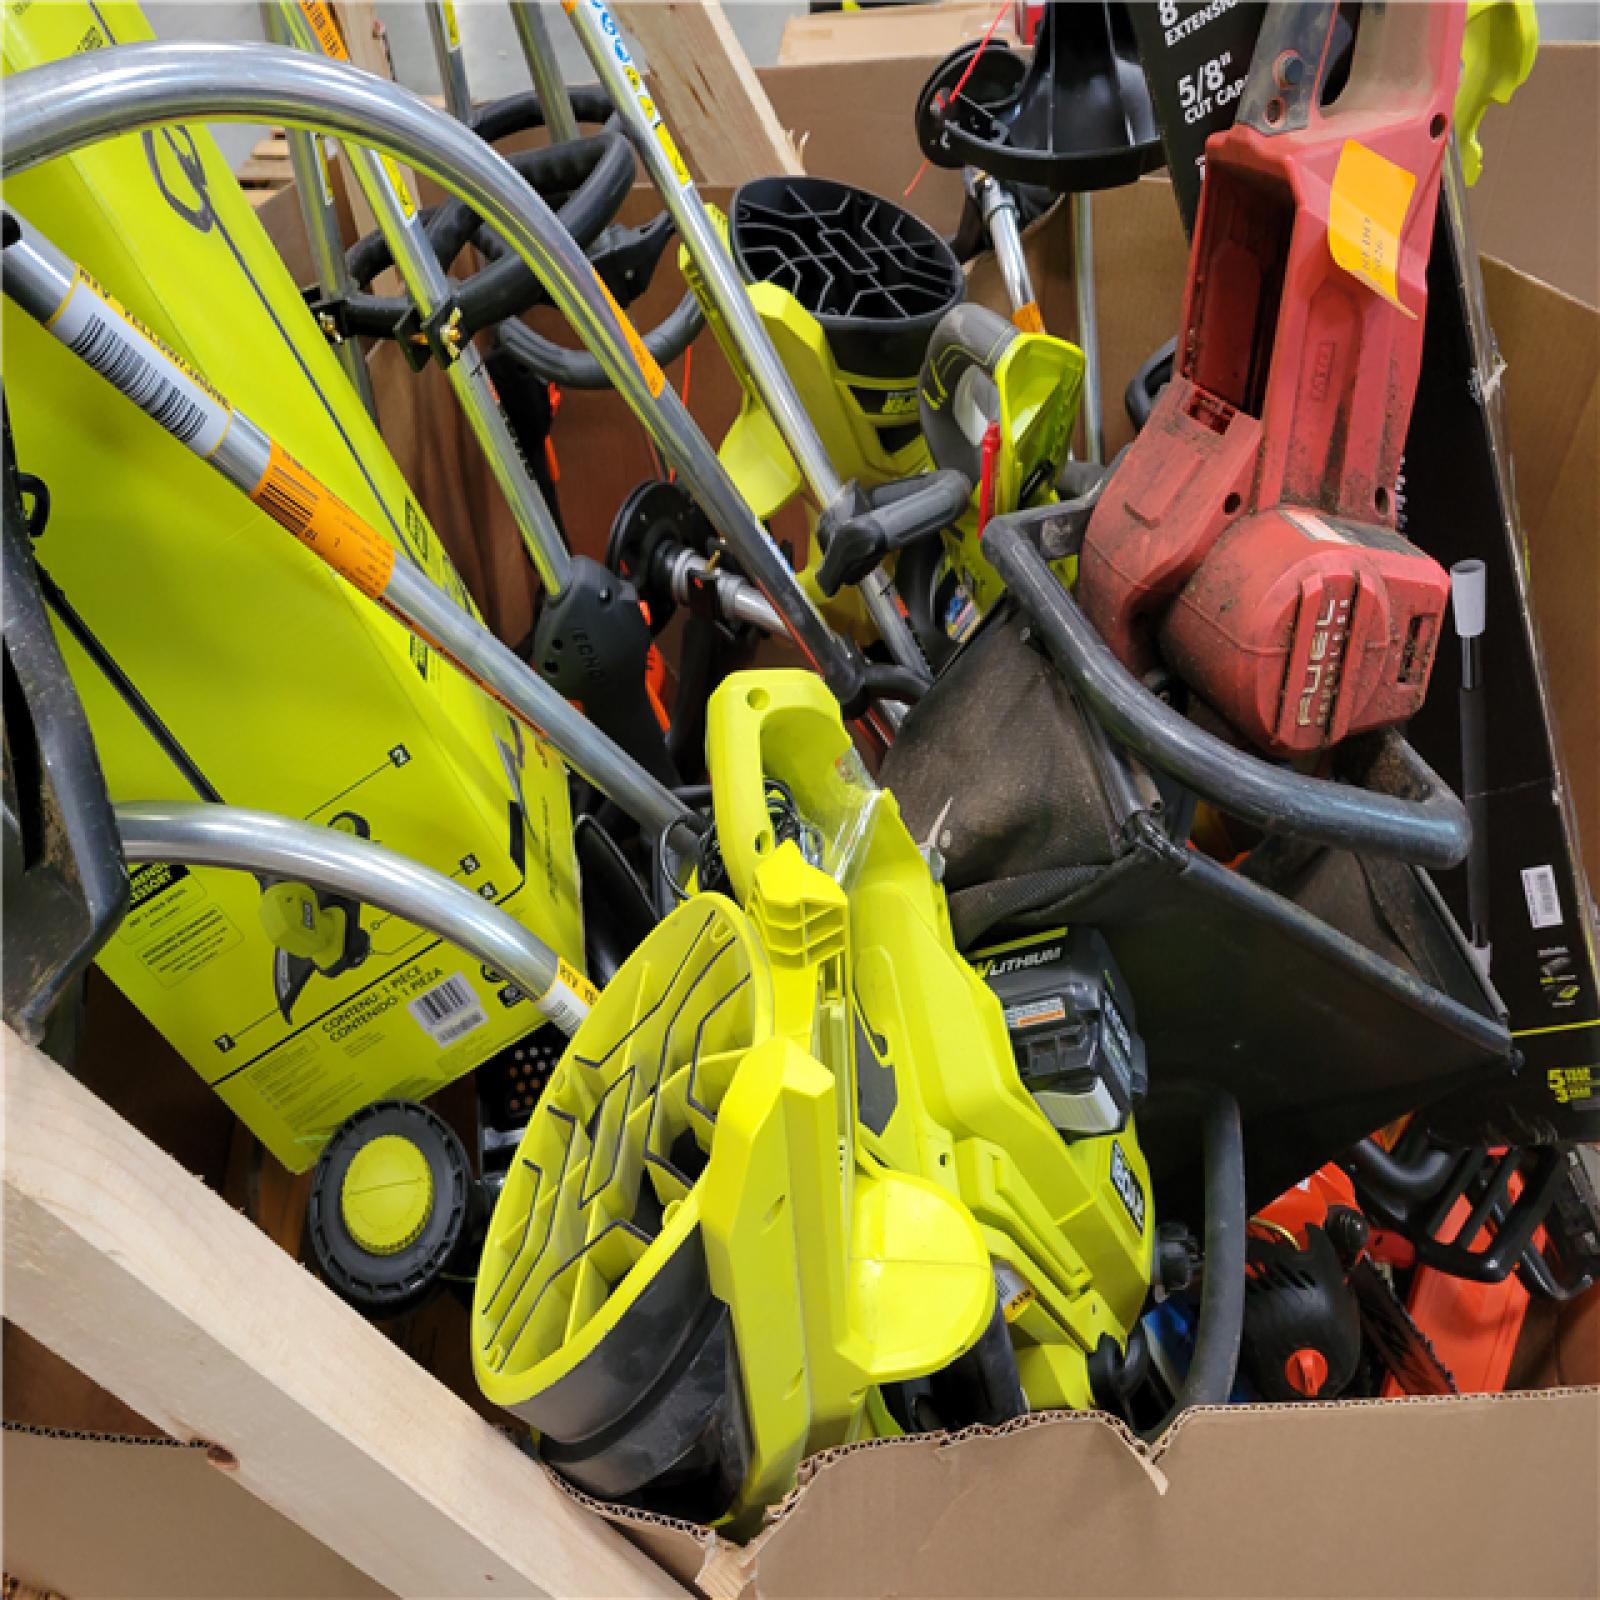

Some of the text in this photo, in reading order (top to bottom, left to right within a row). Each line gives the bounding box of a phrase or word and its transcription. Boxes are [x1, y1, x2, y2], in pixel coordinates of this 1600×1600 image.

[1178, 51, 1231, 108] 5/8"
[1184, 74, 1249, 125] CUT CAP
[571, 627, 606, 683] ECHO
[1298, 599, 1336, 727] FUEL
[989, 946, 1062, 976] LITHIUM
